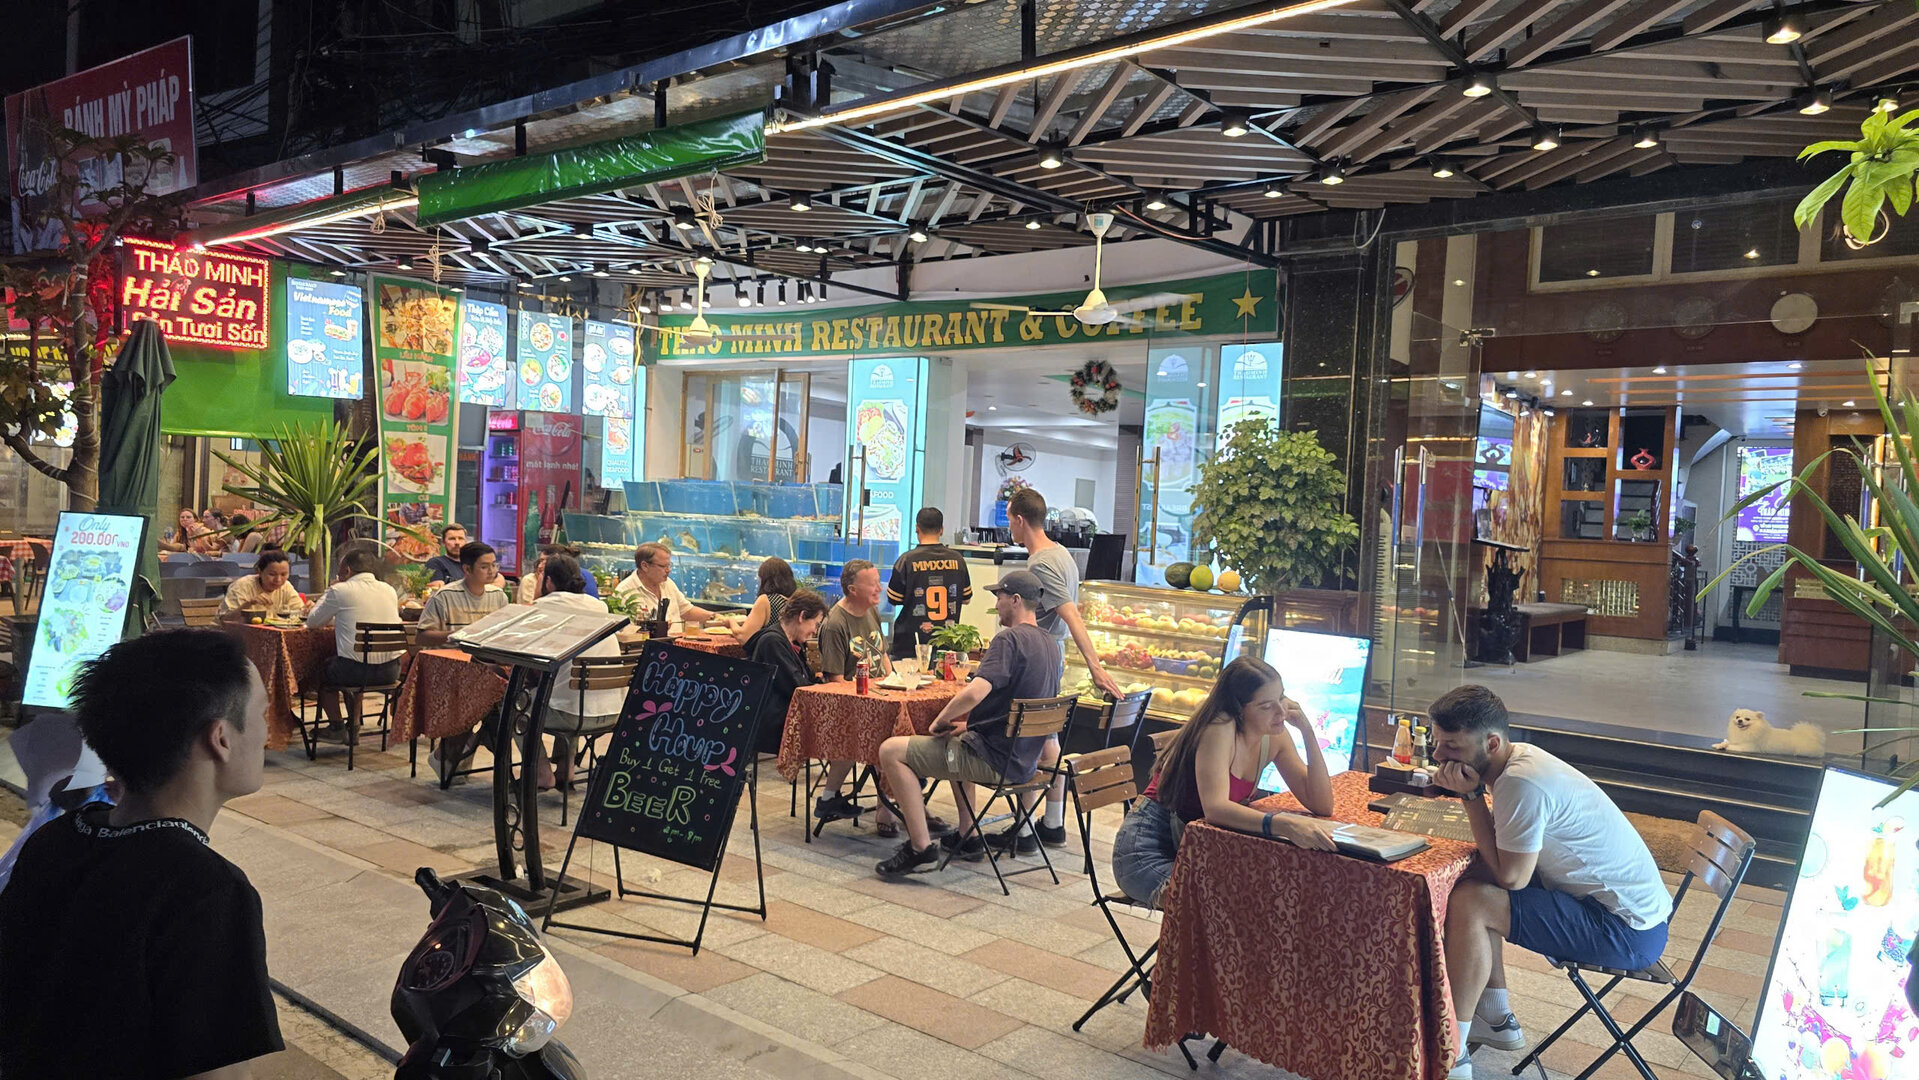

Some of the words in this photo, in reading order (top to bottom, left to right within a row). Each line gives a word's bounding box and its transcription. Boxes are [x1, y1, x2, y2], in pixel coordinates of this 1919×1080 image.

[136, 69, 180, 130] PHÁP
[205, 261, 263, 288] MINH
[191, 287, 257, 321] Sản
[328, 304, 352, 317] Food
[176, 317, 223, 339] Tươi
[730, 321, 803, 354] MINH
[811, 310, 1010, 352] RESTAURANT
[1019, 312, 1044, 342] &
[1055, 293, 1205, 339] CFEE
[78, 516, 111, 533] Only
[912, 560, 958, 572] MMXXIII
[926, 586, 948, 620] 9
[642, 661, 743, 724] Happy
[619, 747, 641, 772] Buy
[642, 757, 652, 770] 1
[658, 758, 680, 776] Get
[684, 768, 694, 782] 1
[700, 770, 722, 789] Free
[603, 771, 697, 825] BEER
